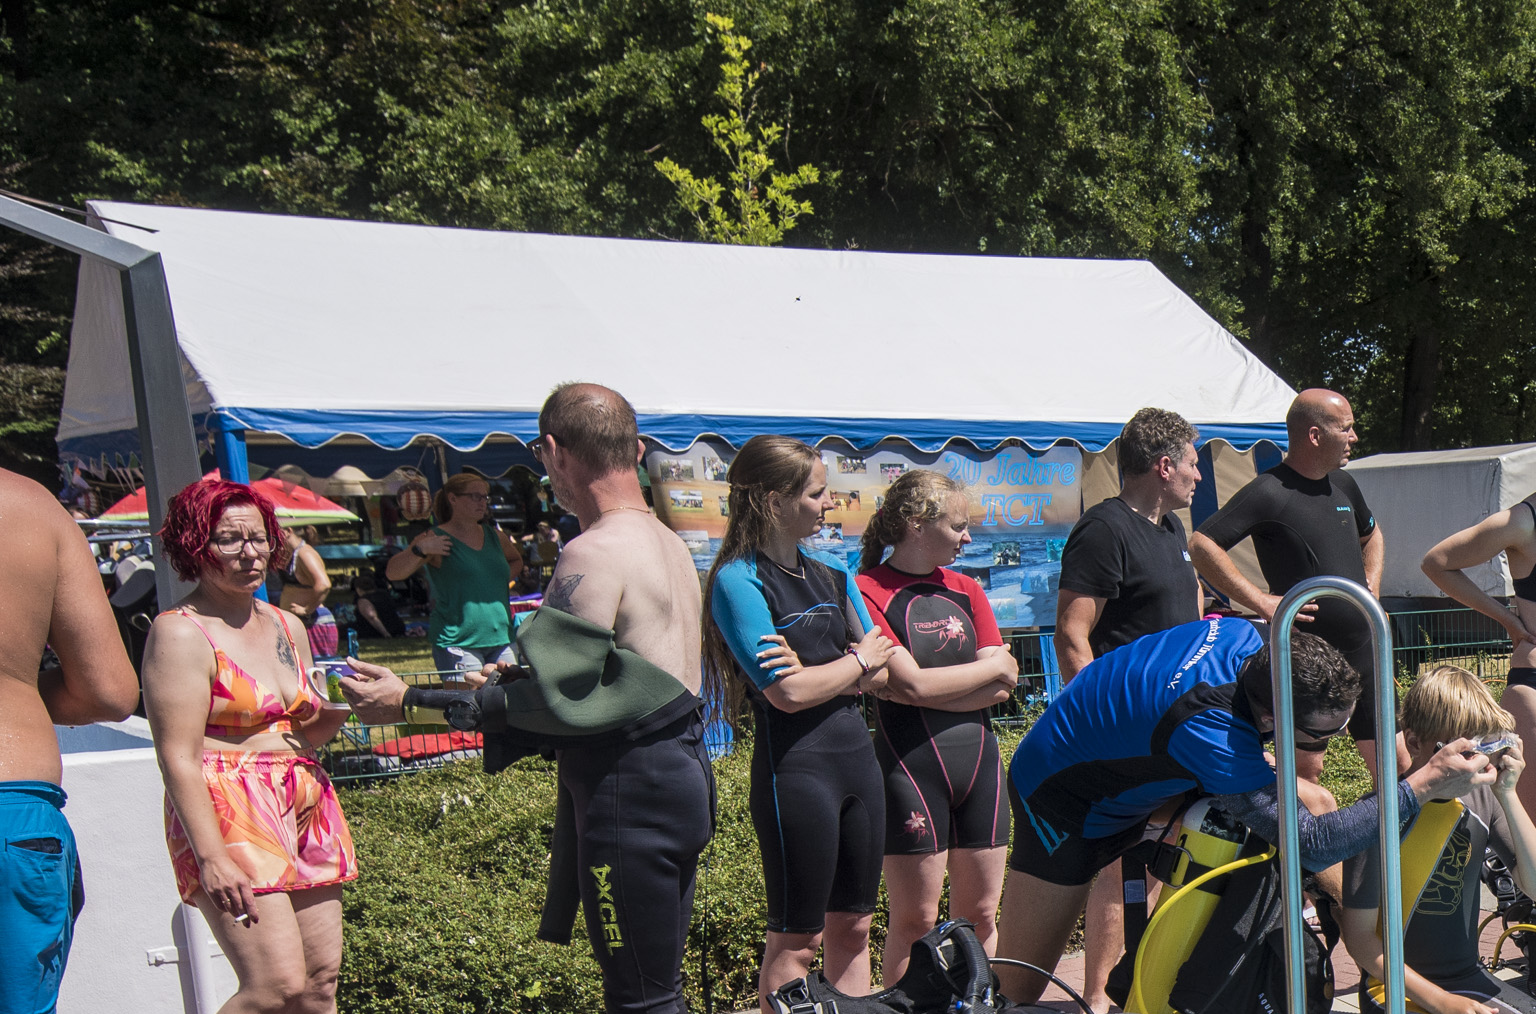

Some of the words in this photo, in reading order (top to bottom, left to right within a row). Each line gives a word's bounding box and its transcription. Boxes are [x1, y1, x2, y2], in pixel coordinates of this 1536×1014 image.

[945, 451, 981, 486] 20
[987, 452, 1076, 486] Jahre
[981, 494, 1053, 527] TCT
[1167, 672, 1183, 690] e.V.
[589, 864, 624, 956] AXCEL
[1258, 992, 1274, 1014] AQUA
